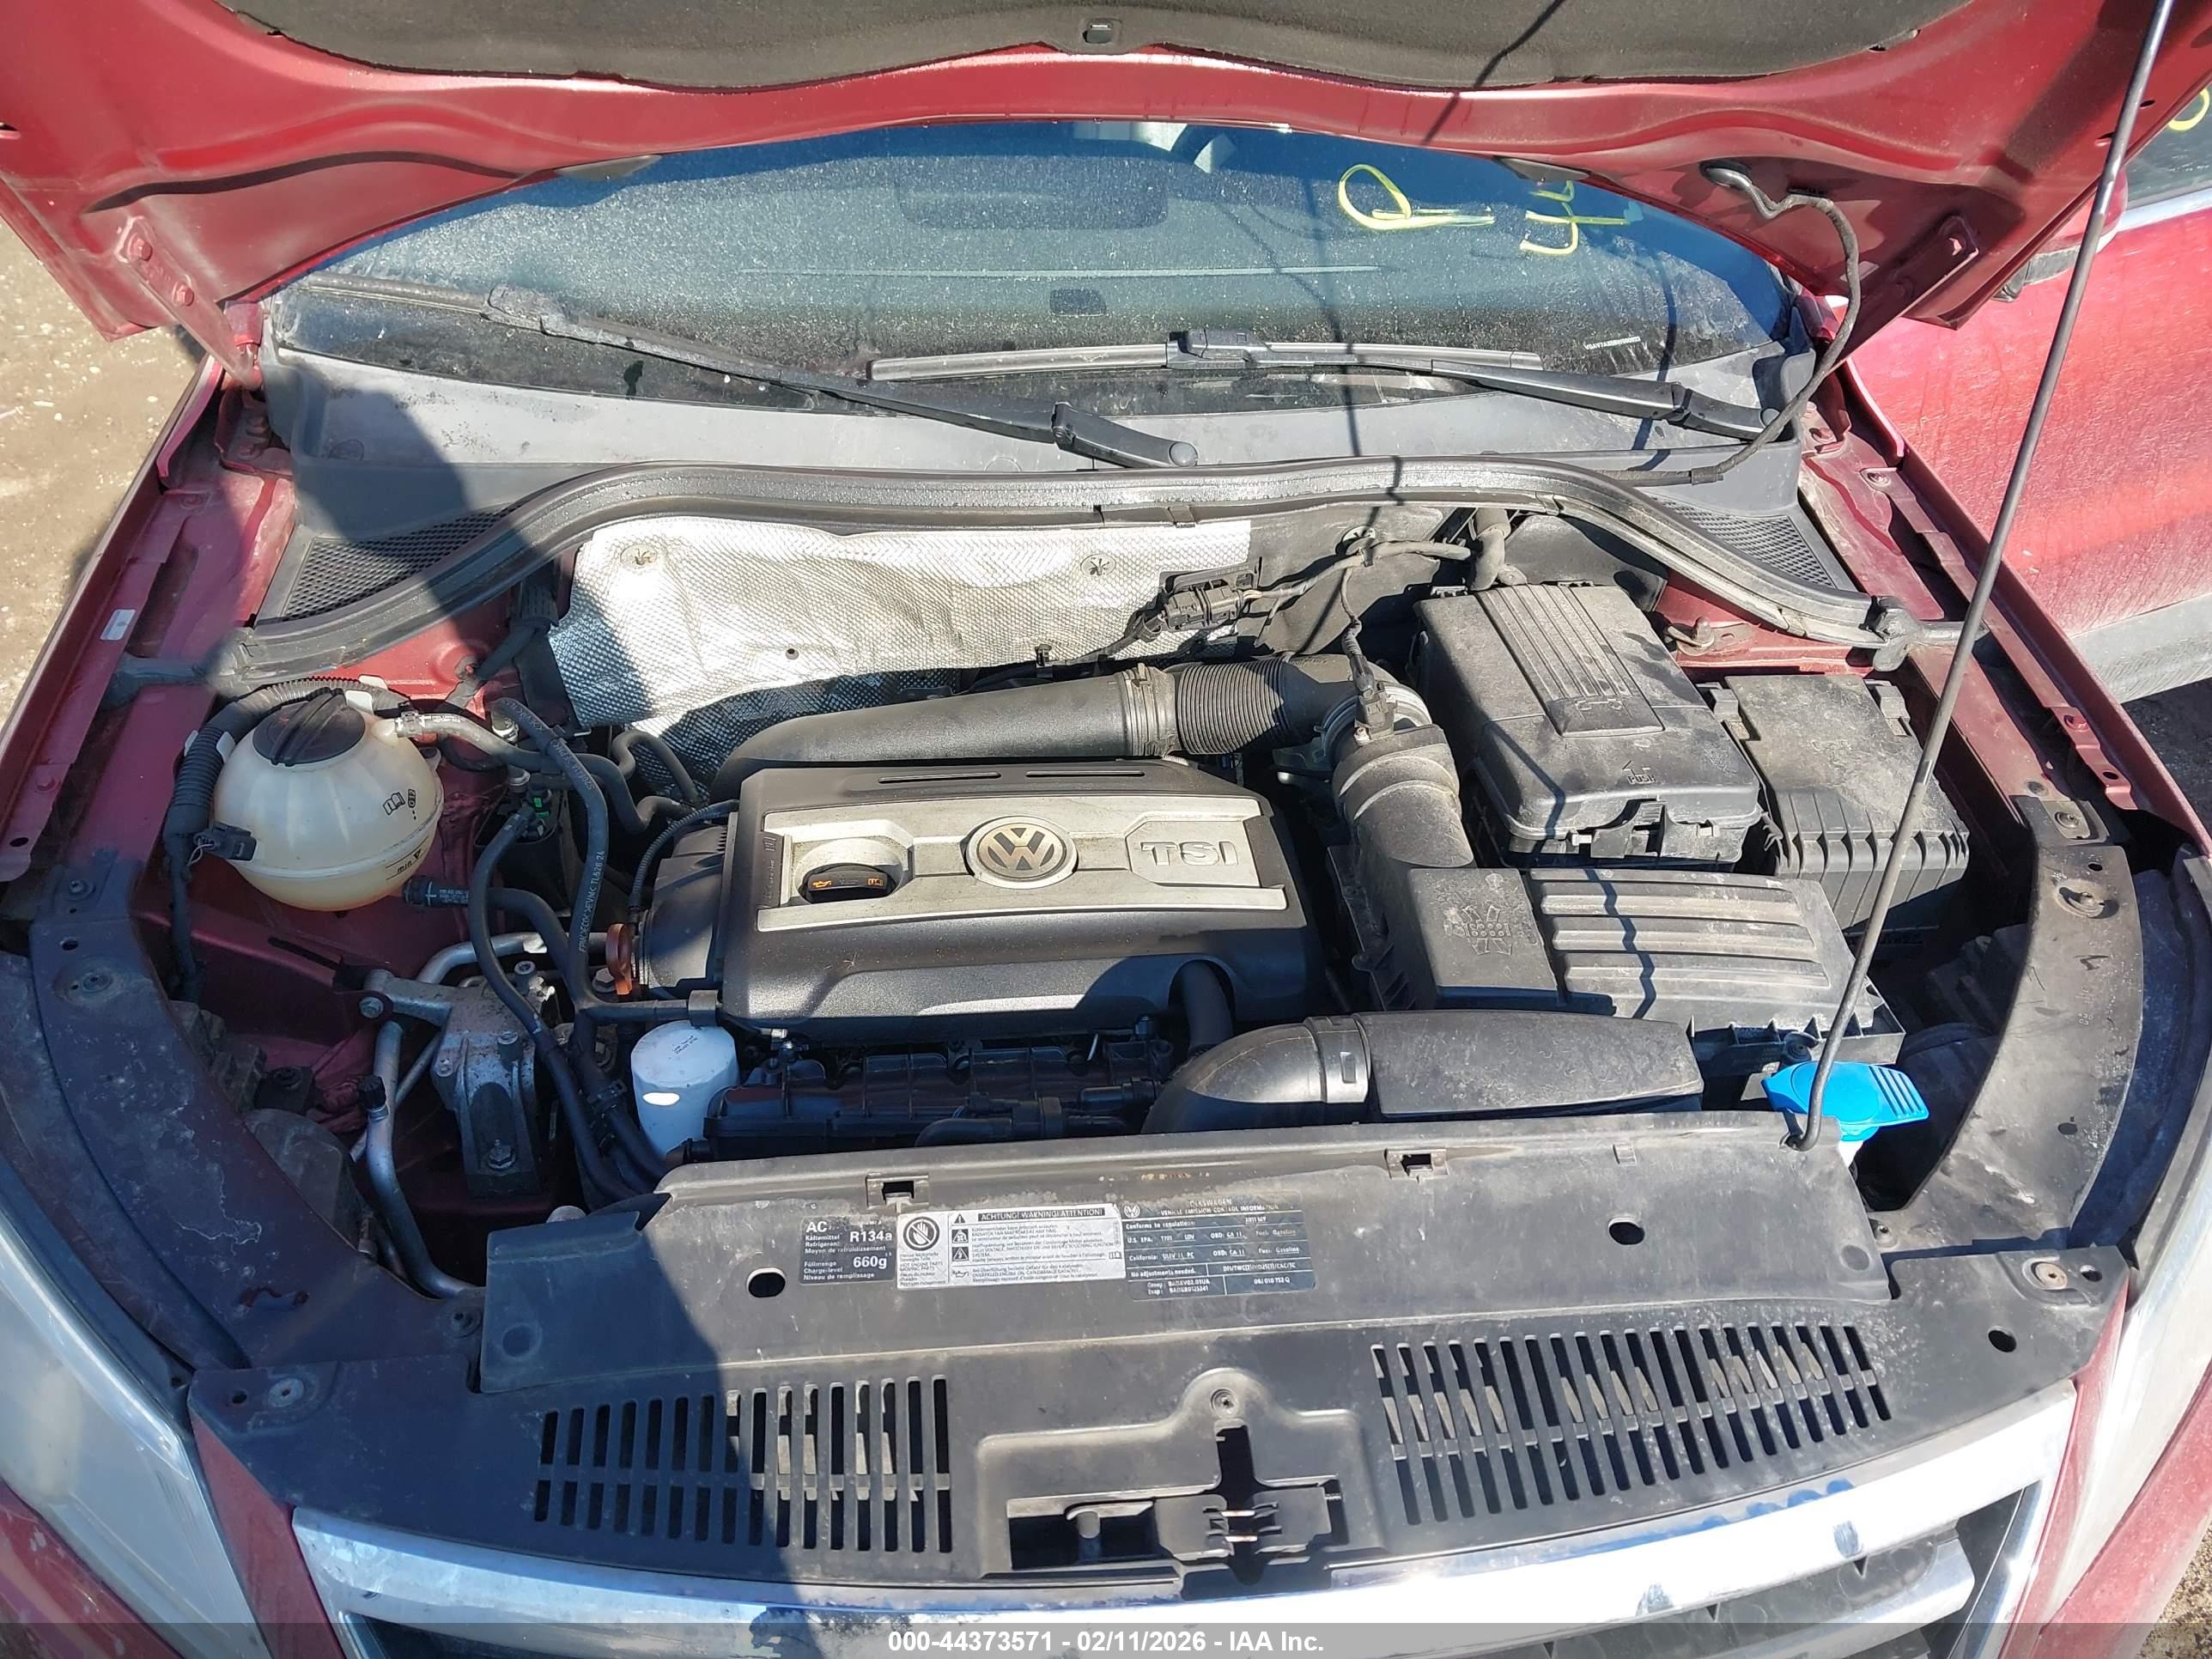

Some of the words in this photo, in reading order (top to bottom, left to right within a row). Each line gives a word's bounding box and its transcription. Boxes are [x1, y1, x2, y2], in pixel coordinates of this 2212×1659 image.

[1628, 775, 1656, 785] PUSH
[1140, 841, 1240, 866] TSI
[398, 860, 412, 874] min
[981, 1212, 1019, 1221] ACHTUNG!
[1021, 1211, 1060, 1219] WARNING!
[1061, 1208, 1103, 1218] ATTENTION!
[805, 1221, 828, 1233] AC
[850, 1231, 893, 1243] R134a
[853, 1255, 887, 1269] 660g
